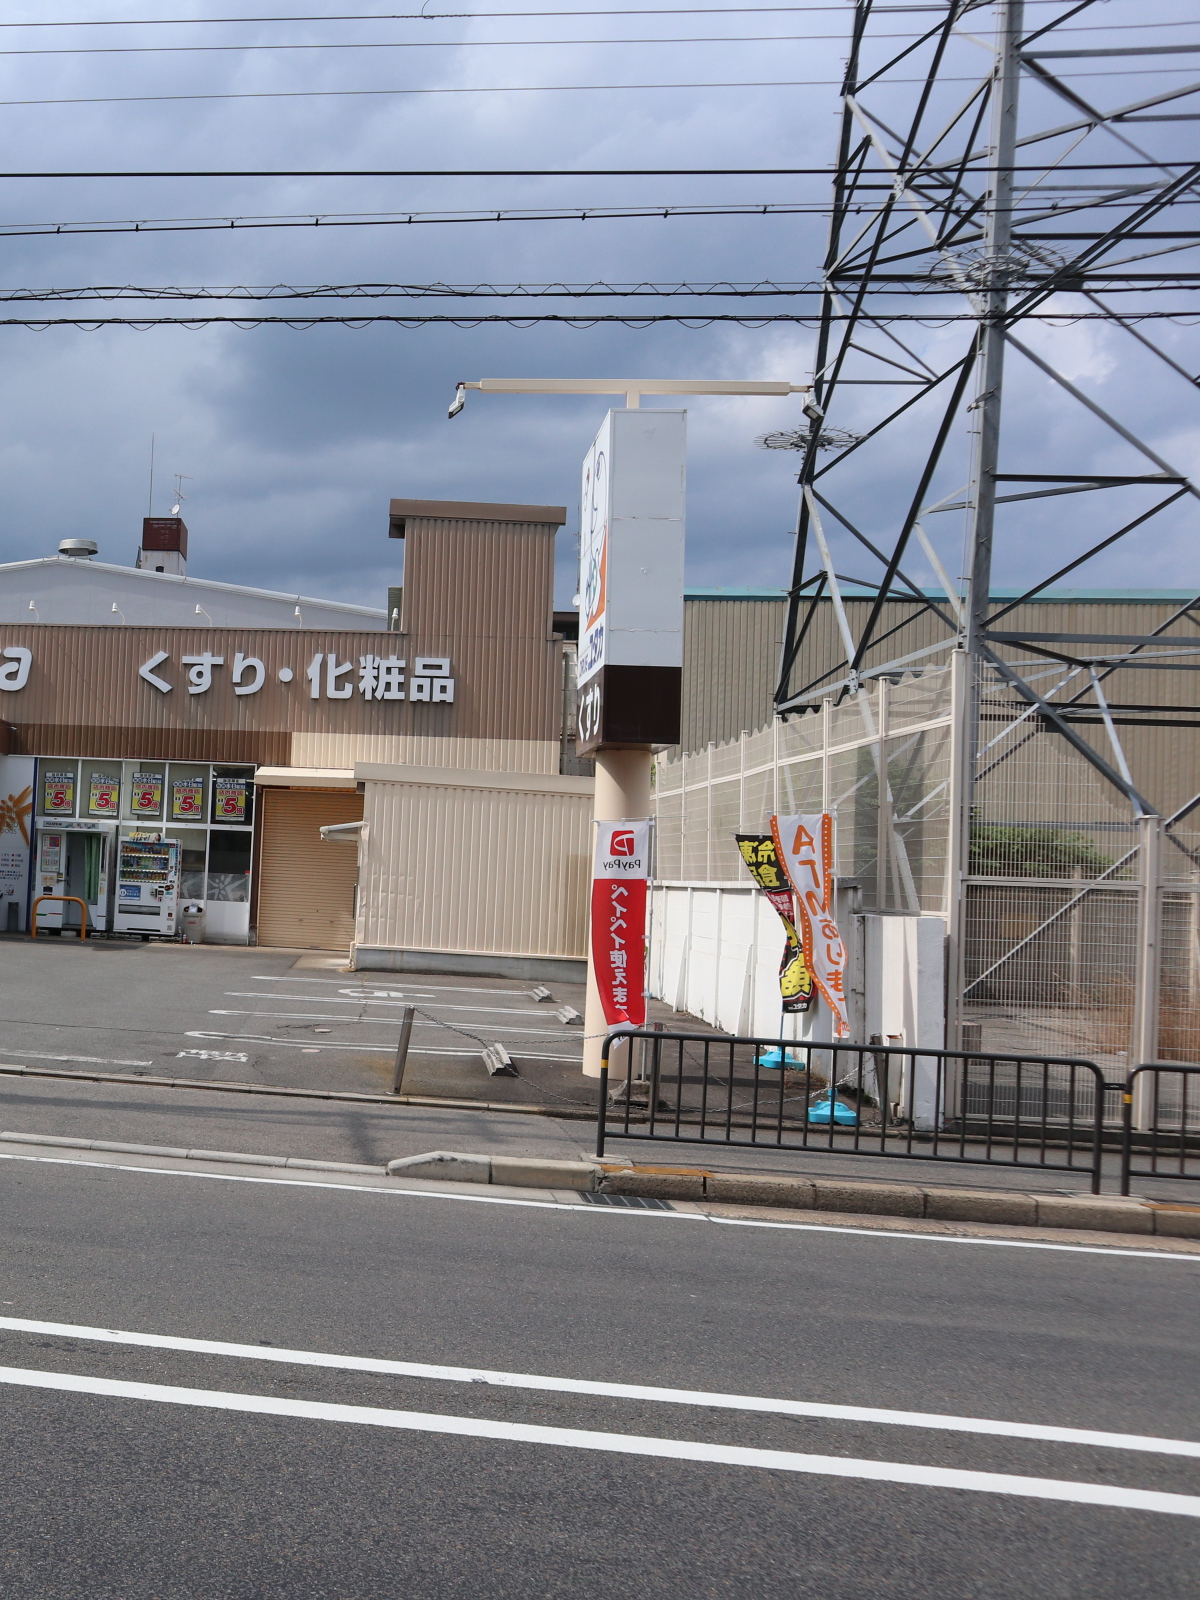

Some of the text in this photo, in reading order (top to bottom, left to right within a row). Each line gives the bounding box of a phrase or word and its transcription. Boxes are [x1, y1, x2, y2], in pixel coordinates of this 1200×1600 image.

[139, 650, 455, 703] くすり・化粧品
[579, 683, 600, 743] くすり
